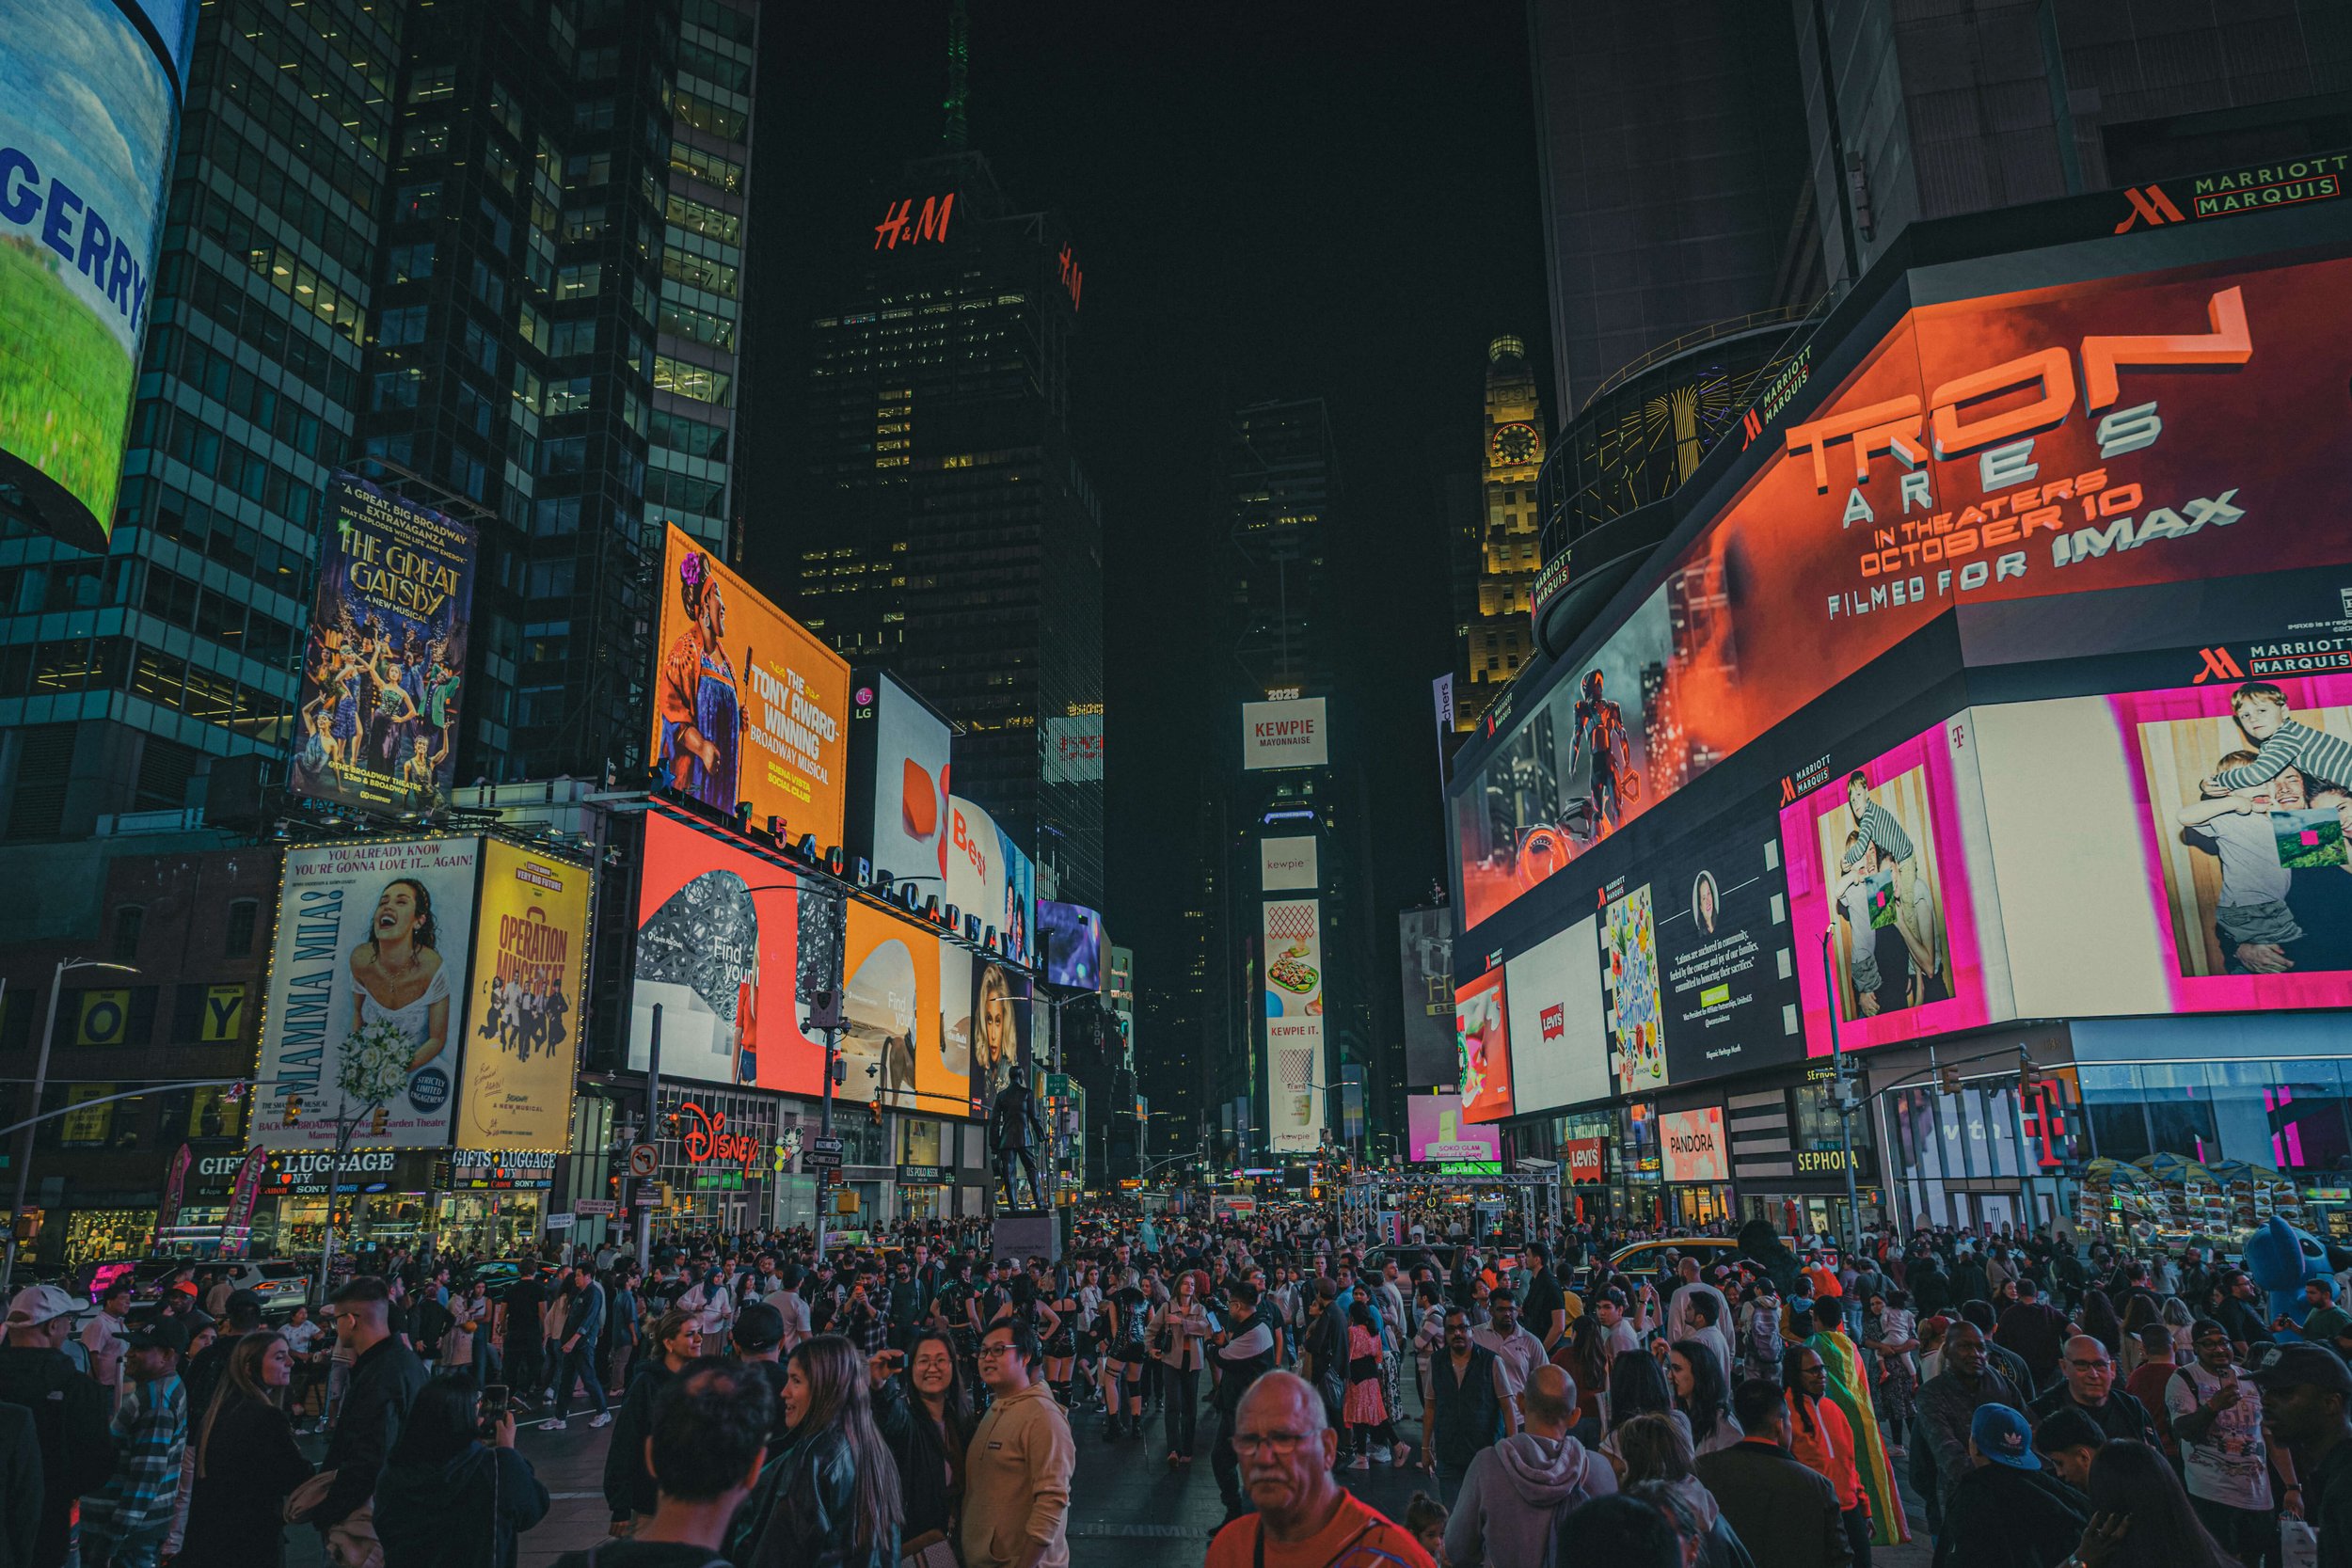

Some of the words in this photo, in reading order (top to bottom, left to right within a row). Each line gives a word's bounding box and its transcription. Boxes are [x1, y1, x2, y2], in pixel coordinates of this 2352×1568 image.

[2195, 155, 2348, 195] MARRIOTT
[2200, 179, 2334, 214] MARQUIS
[874, 192, 954, 251] H&M
[1764, 344, 1811, 407] MARRIOTT
[1766, 370, 1806, 424] MARQUIS
[1785, 285, 2253, 494] TRON
[1843, 401, 2163, 529] ARES
[355, 489, 390, 511] GREAT,
[393, 505, 411, 519] BIG
[414, 515, 467, 544] BROADWAY
[1874, 527, 1896, 549] IN
[1901, 467, 2108, 544] THEATERS
[340, 506, 358, 517] THAT
[358, 515, 393, 533] EXPLODES
[394, 529, 411, 540] WITH
[412, 536, 425, 546] LIFE
[425, 543, 439, 553] AND
[366, 505, 445, 547] EXTRAVAGANZA
[1860, 506, 2063, 578] OCTOBER
[2082, 483, 2143, 522] 10
[342, 527, 382, 565] THE
[386, 546, 461, 597] GREAT
[1828, 576, 1925, 620] FILMED
[1938, 551, 2027, 597] FOR
[2052, 488, 2247, 568] IMAX
[1535, 550, 1572, 589] MARRIOTT
[350, 562, 446, 616] GATSBY
[1536, 570, 1567, 608] MARQUIS
[372, 597, 391, 610] NEW
[392, 604, 428, 624] MUSICAL
[2253, 654, 2349, 673] MARQUIS
[752, 663, 789, 711] TONY
[787, 668, 804, 695] THE
[1268, 689, 1298, 701] 2025
[856, 708, 872, 719] LG
[1495, 692, 1513, 716] MARRIOTT
[765, 703, 819, 761] WINNING
[1256, 720, 1314, 736] KEWPIE
[1495, 708, 1512, 729] MARQUIS
[750, 724, 797, 766] BROADWAY
[798, 752, 828, 785] MUSICAL
[1260, 736, 1311, 747] MAYONNAISE
[351, 765, 391, 783] BROADWAY
[392, 777, 422, 792] THEATRE
[769, 761, 791, 781] BUENA
[791, 774, 811, 792] VISTA
[1796, 753, 1831, 782] MARRIOTT
[369, 779, 408, 796] BROADWAY
[768, 773, 791, 793] SOCIAL
[791, 785, 811, 803] CLUB
[1798, 770, 1828, 793] MARQUIS
[329, 849, 351, 861] YOU
[355, 847, 404, 859] ALREADY
[407, 844, 441, 856] KNOW
[953, 808, 986, 886] Best
[295, 863, 333, 876] YOU'RE
[337, 861, 375, 873] GONNA
[379, 859, 407, 870] LOVE
[433, 855, 472, 867] AGAIN!
[1267, 857, 1304, 871] kewpie
[516, 869, 531, 880] VERY
[532, 875, 541, 884] BIG
[542, 877, 562, 891] FUTURE
[1606, 876, 1625, 892] MARRIOTT
[1607, 886, 1624, 901] MARQUIS
[850, 856, 1018, 962] BROADWAY
[293, 890, 344, 962] MIA!
[500, 913, 567, 963] OPERATION
[714, 936, 741, 963] Find
[888, 991, 906, 1011] Find
[275, 969, 334, 1099] MAMMA
[1271, 1026, 1305, 1036] KEWPIE
[1309, 1026, 1319, 1035] IT.
[416, 1084, 442, 1095] LIMITED
[417, 1076, 446, 1086] STRICTLY
[411, 1092, 445, 1104] ENGAGEMENT
[259, 1122, 280, 1131] BACK
[416, 1117, 446, 1127] Theatre
[1281, 1132, 1310, 1141] kewpie
[1671, 1133, 1714, 1154] PANDORA
[453, 1151, 491, 1167] GIFTS
[501, 1152, 557, 1169] LUGGAGE
[914, 1167, 926, 1177] POLO
[296, 1185, 327, 1194] SONY
[471, 1180, 488, 1188] Nikon
